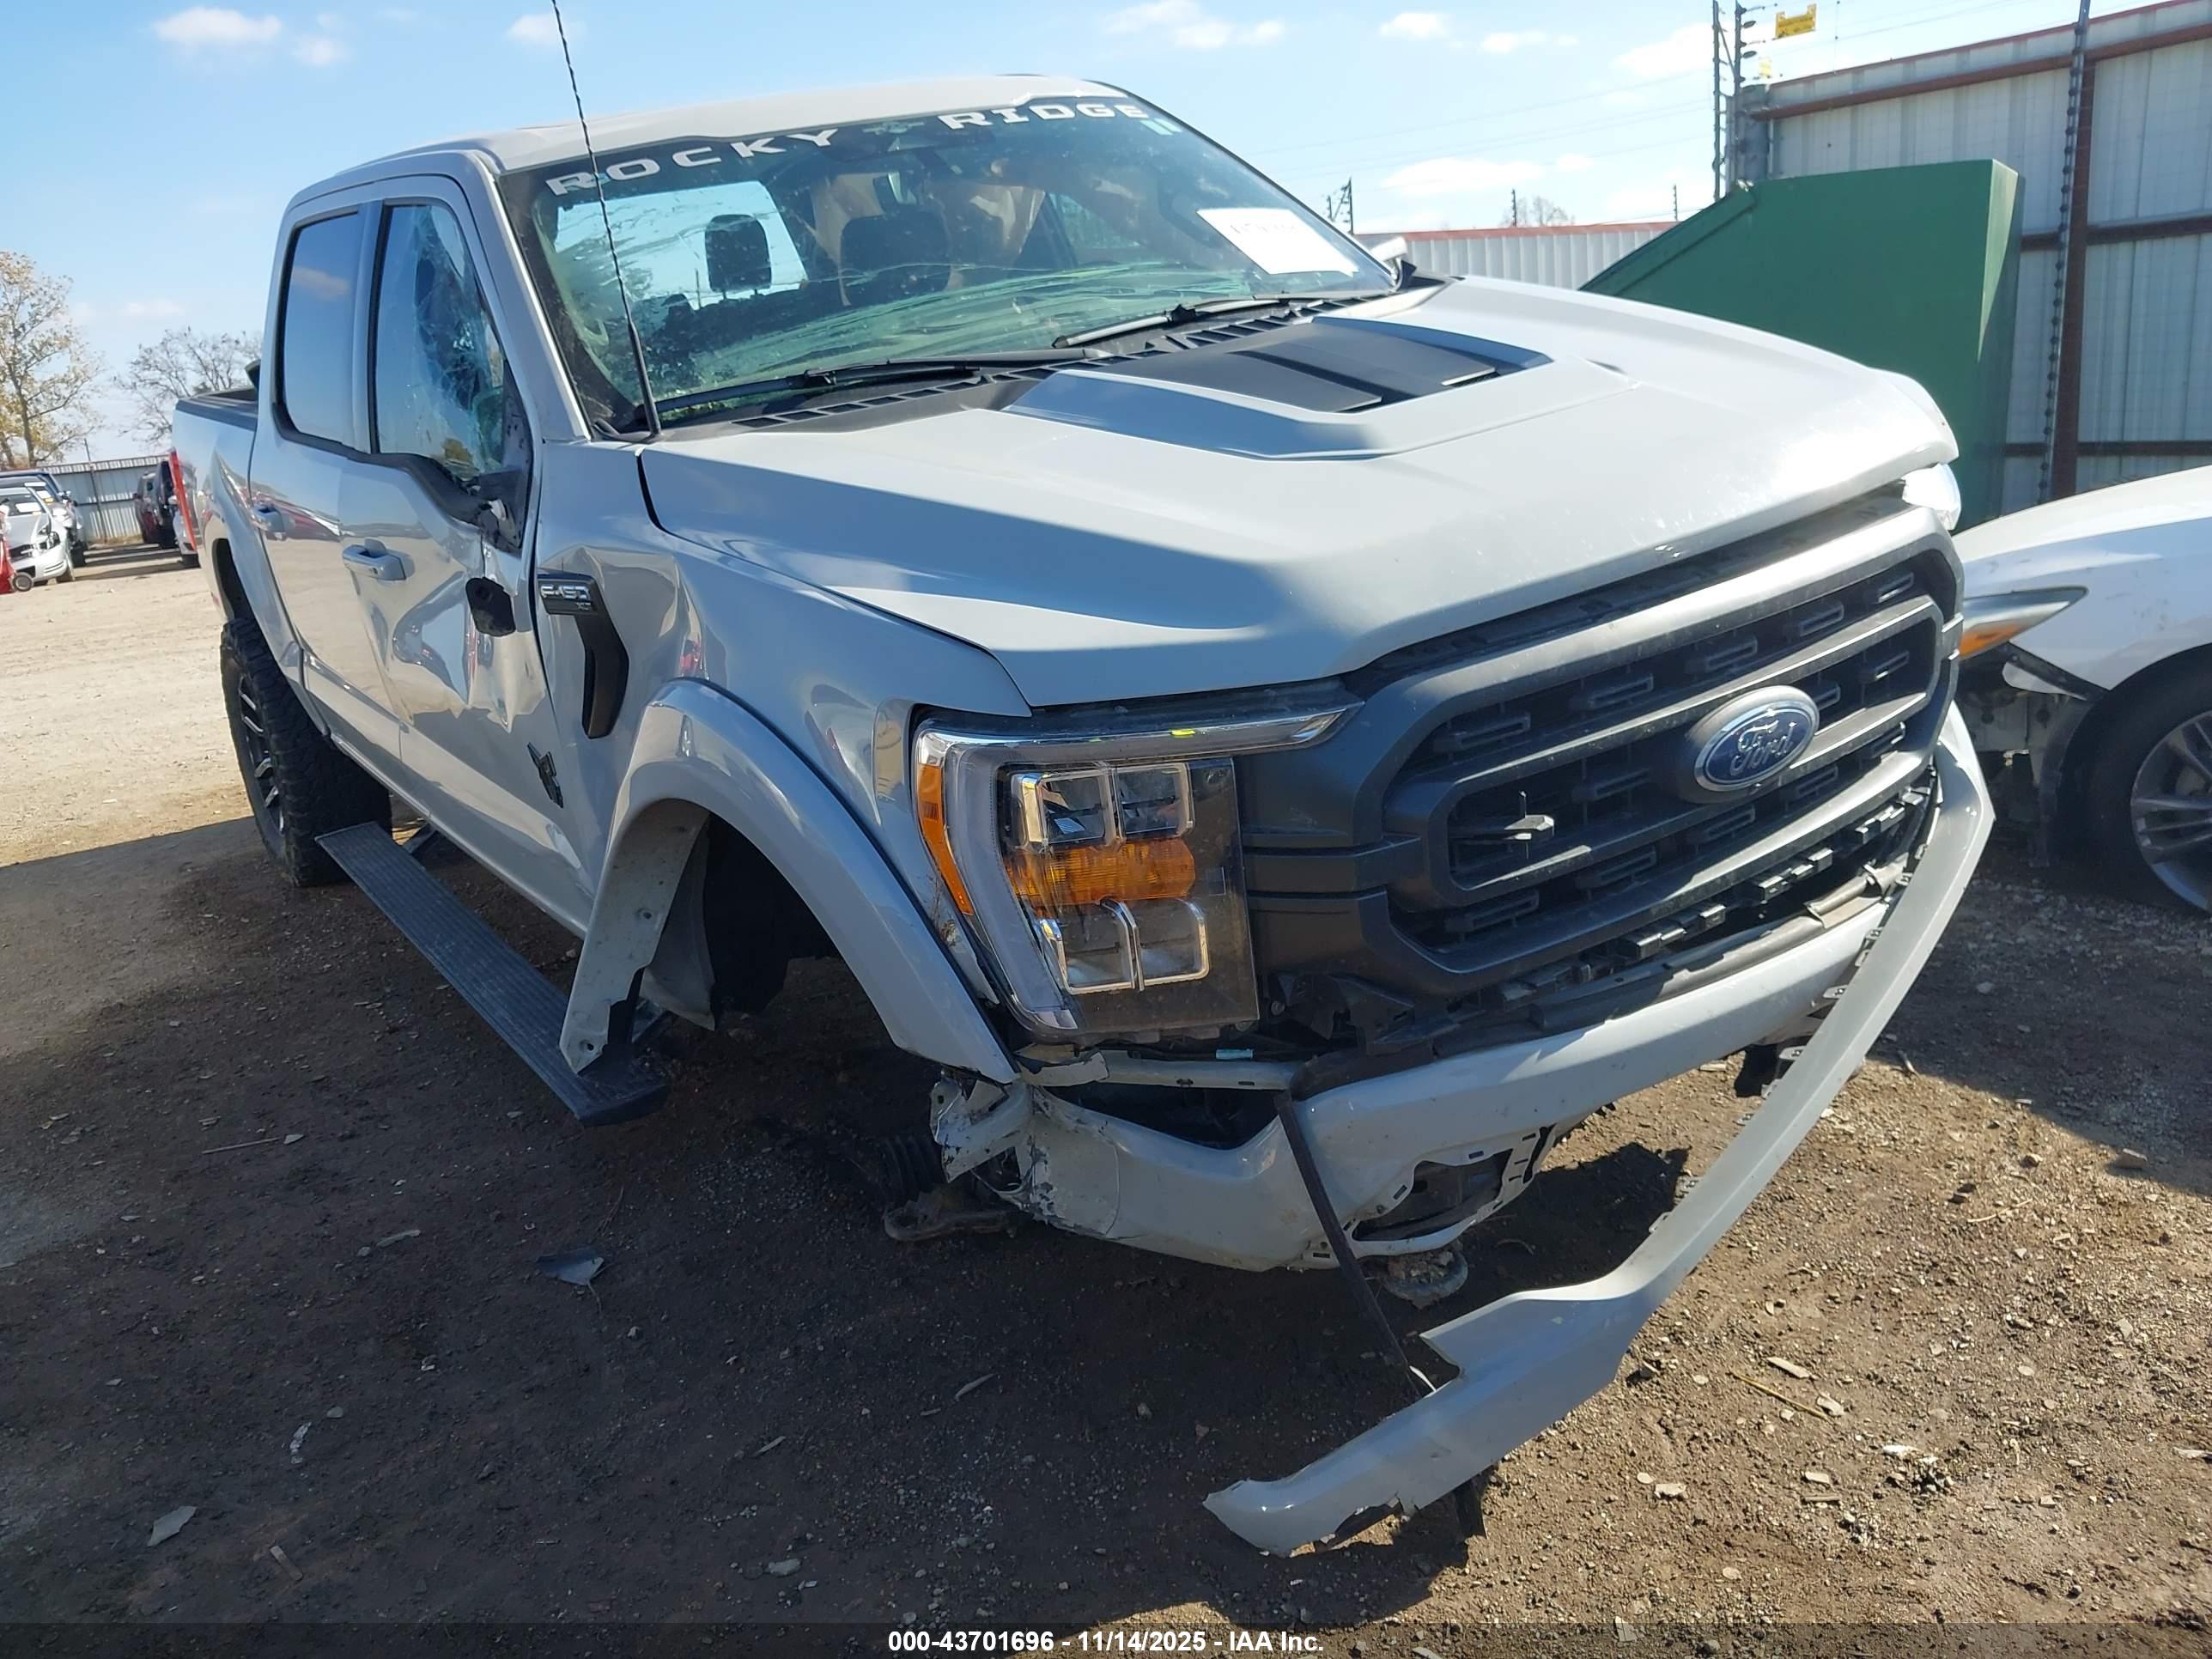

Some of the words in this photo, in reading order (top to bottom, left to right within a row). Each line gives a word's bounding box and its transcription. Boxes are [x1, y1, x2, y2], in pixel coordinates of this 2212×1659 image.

[545, 128, 840, 197] ROCKY
[937, 102, 1149, 131] RIDGE
[1729, 719, 1797, 776] Ford
